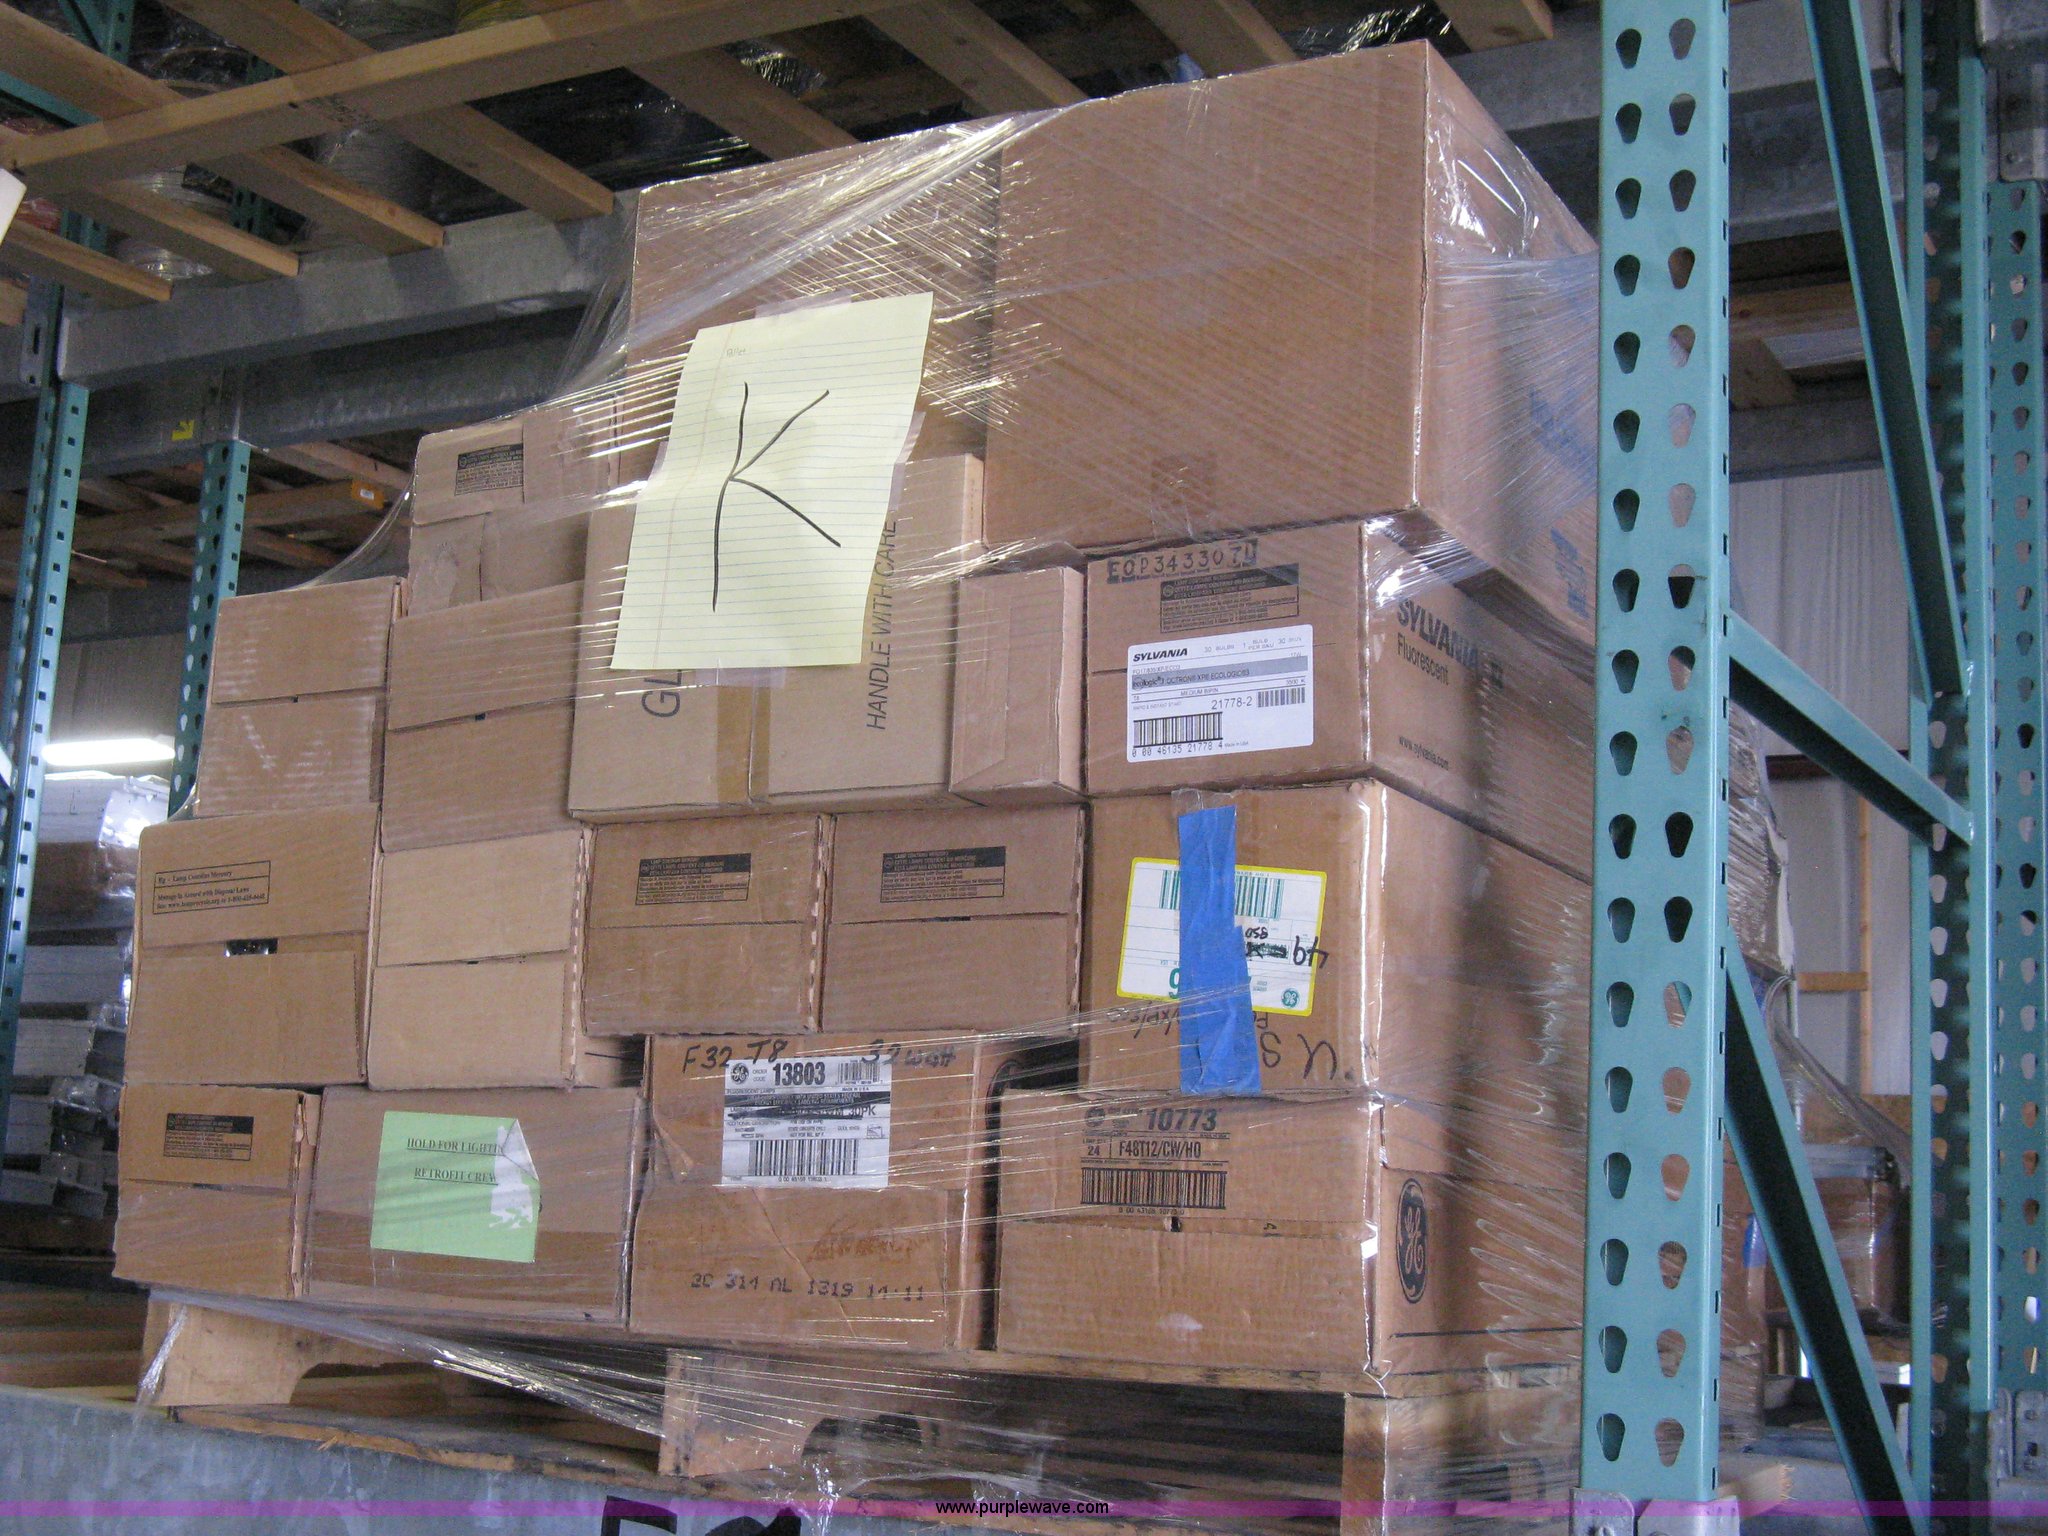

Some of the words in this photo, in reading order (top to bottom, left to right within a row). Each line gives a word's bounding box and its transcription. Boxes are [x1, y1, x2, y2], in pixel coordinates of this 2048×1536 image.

[712, 381, 842, 613] K
[873, 520, 897, 577] CARE
[871, 584, 893, 637] WITH
[1132, 647, 1188, 662] SYLVANIA
[1397, 632, 1449, 686] Fluorescent
[866, 641, 891, 730] HANDLE
[1211, 696, 1253, 710] 21778-2
[1157, 745, 1182, 755] 46135
[1187, 742, 1213, 753] 21778
[772, 1062, 826, 1086] 13803
[1147, 1107, 1217, 1131] 10773
[407, 1138, 436, 1148] HOLD
[438, 1140, 458, 1151] FOR
[1087, 1146, 1100, 1156] 24
[1119, 1140, 1202, 1159] F48T12/CW/HO
[414, 1167, 464, 1178] RETROFIT
